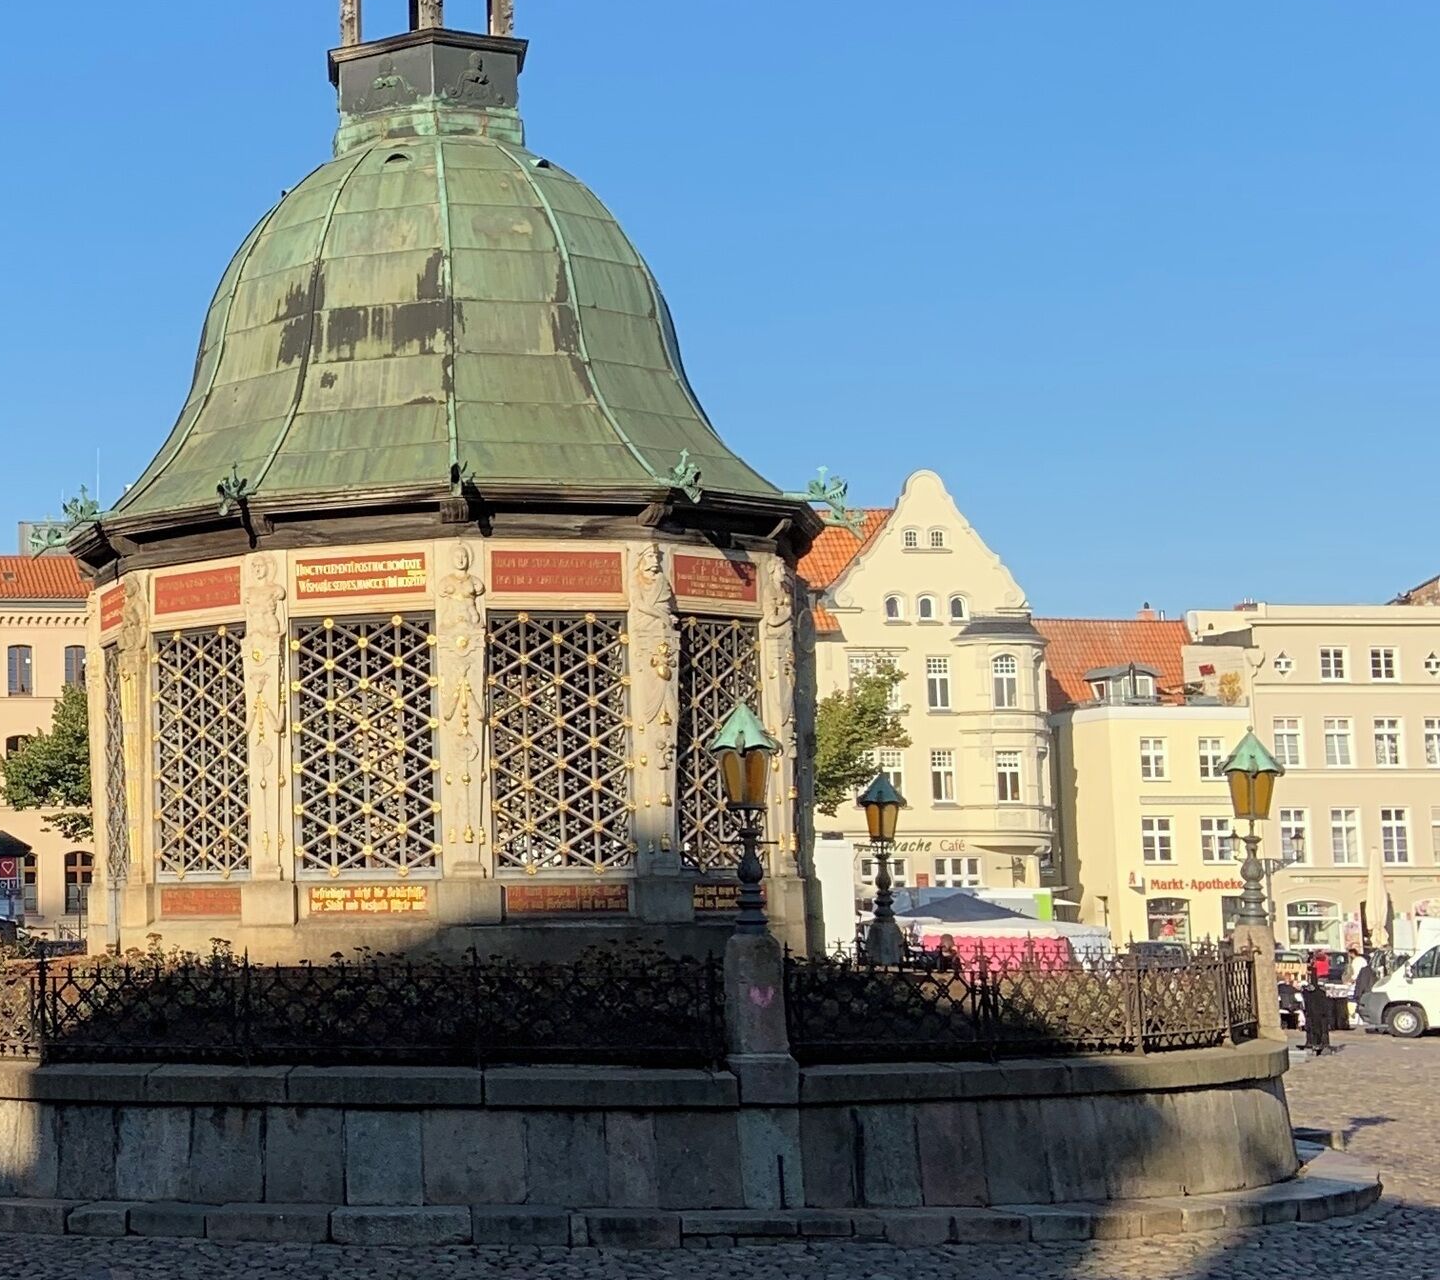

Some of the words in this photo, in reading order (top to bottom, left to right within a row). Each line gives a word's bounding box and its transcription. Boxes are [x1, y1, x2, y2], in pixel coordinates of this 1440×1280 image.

[940, 839, 966, 852] Café
[1151, 878, 1184, 890] Markt
[1191, 878, 1244, 892] Apotheke
